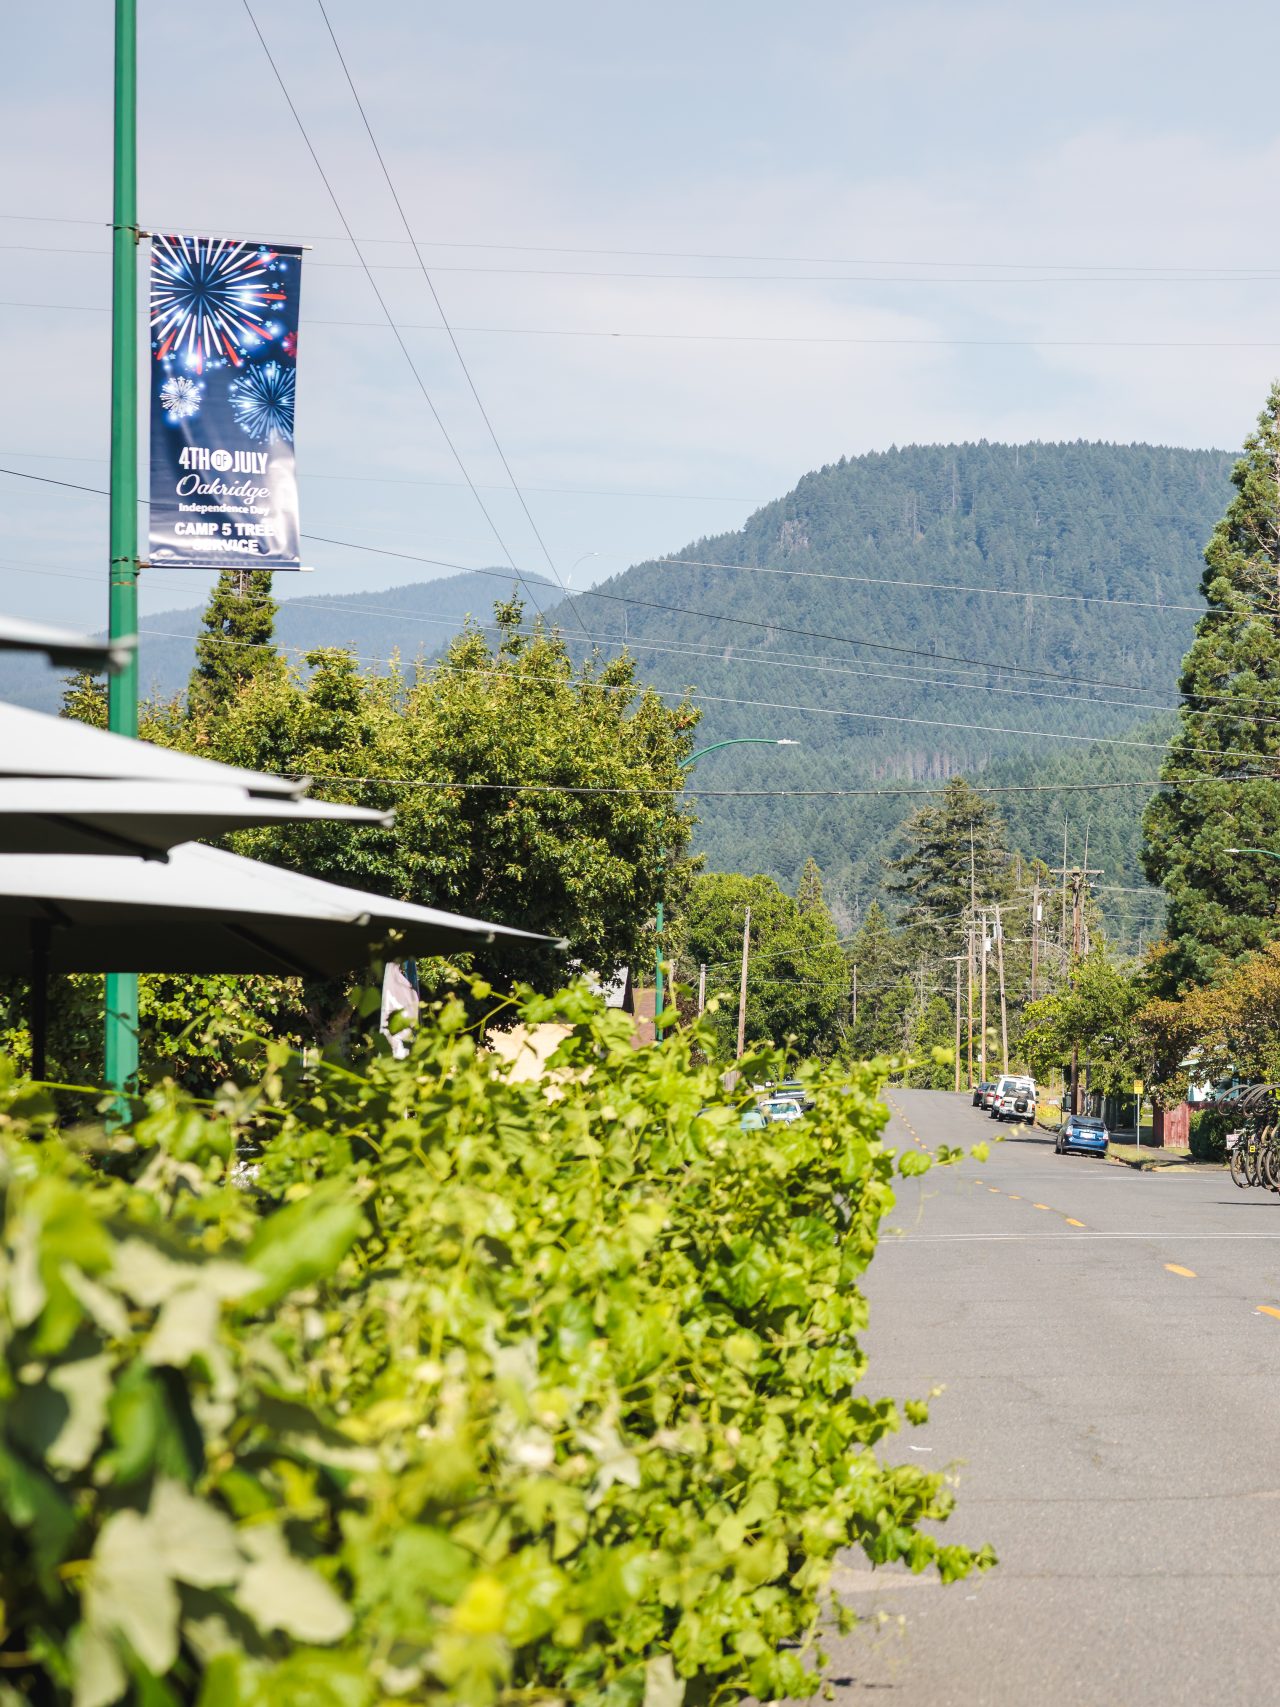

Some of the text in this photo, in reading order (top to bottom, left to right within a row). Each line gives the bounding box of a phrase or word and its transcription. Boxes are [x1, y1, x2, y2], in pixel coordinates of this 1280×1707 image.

[178, 447, 211, 470] 4TH
[232, 450, 269, 474] JULY
[176, 473, 271, 504] Oakridge
[178, 502, 270, 516] Independence Day
[174, 522, 275, 537] CAMP 5 TREE
